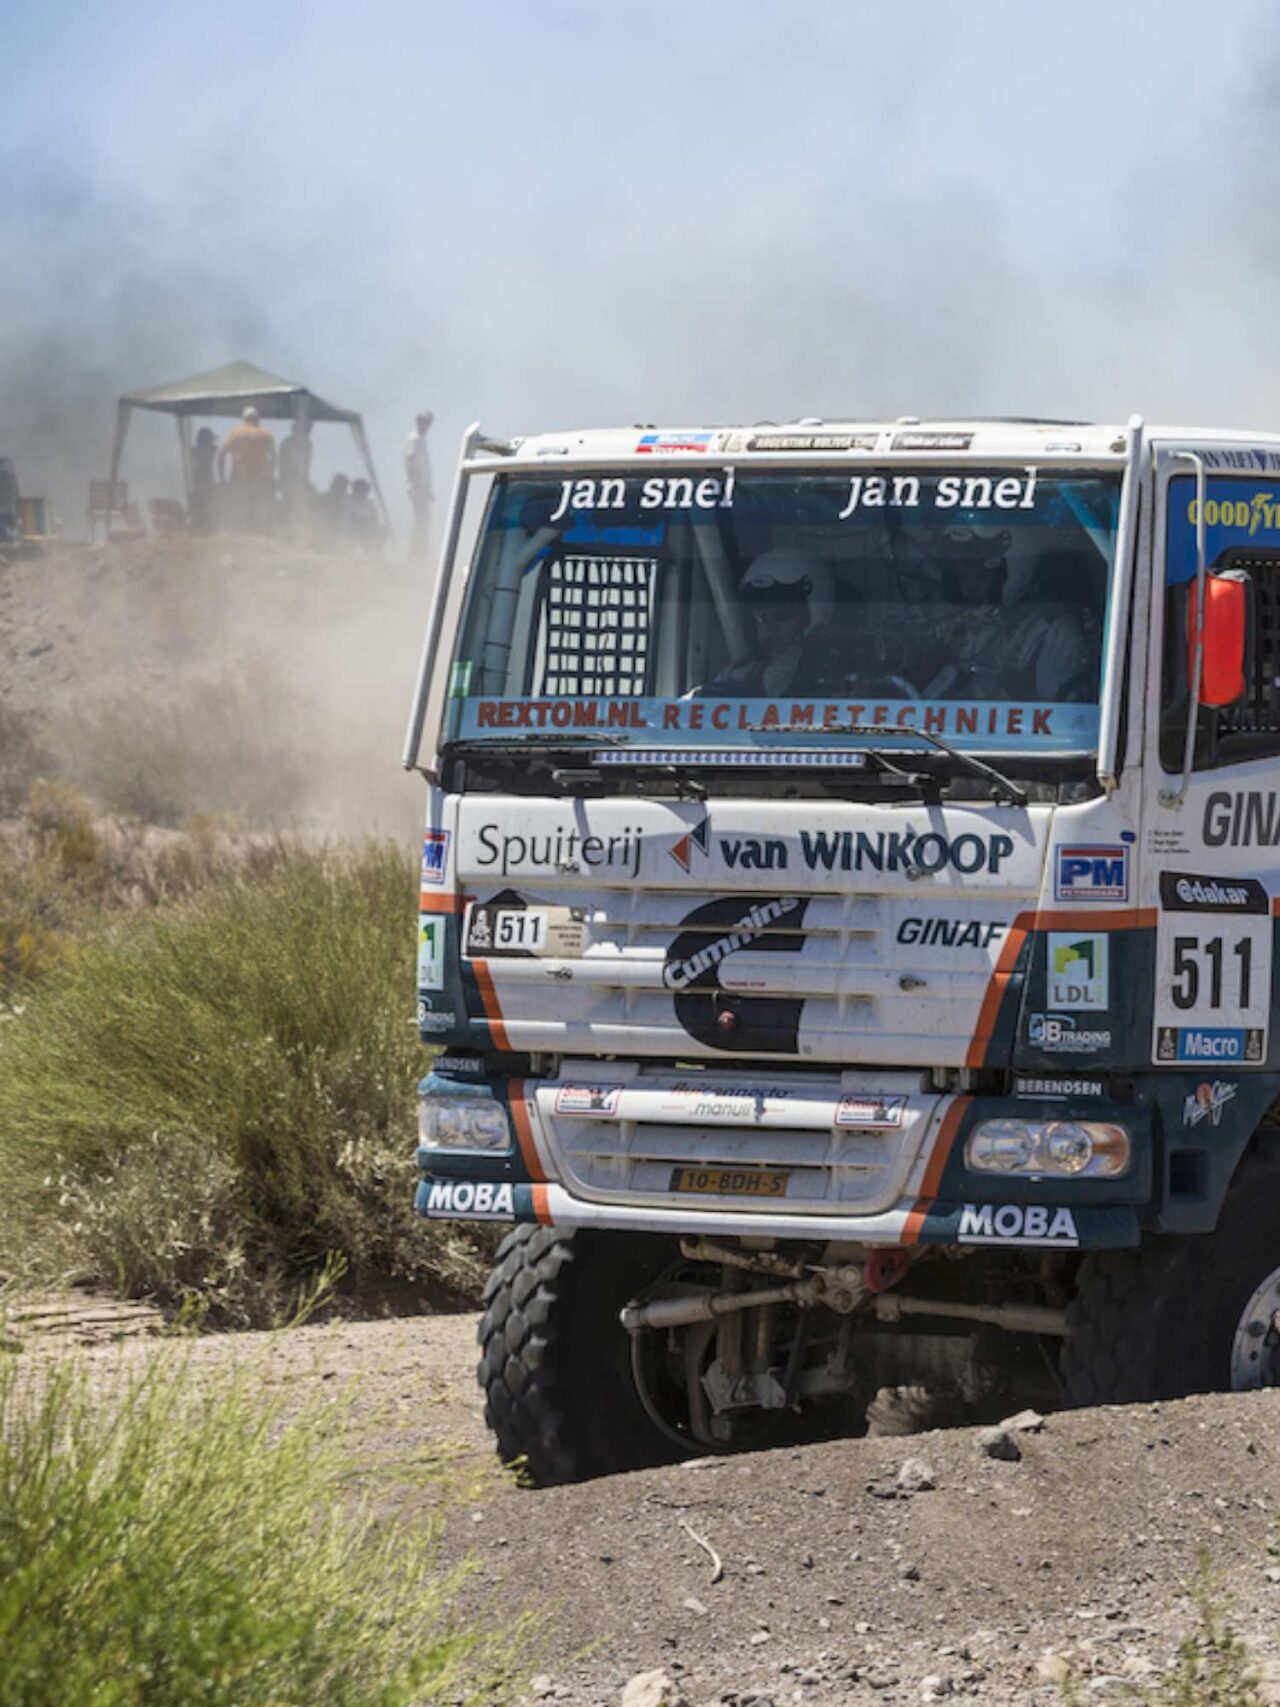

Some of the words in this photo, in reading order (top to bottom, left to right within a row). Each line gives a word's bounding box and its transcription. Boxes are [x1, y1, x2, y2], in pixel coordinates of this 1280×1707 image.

[551, 477, 626, 520] jan
[641, 468, 735, 509] snel
[839, 475, 919, 519] jan
[934, 468, 1037, 510] snel
[477, 698, 646, 730] REXTOM.NL
[662, 703, 1053, 736] RECLAMETECHNIEK
[476, 824, 643, 878] Spuiterij
[720, 838, 788, 870] van
[800, 830, 1014, 874] WINKOOP
[1061, 859, 1125, 887] PM
[1177, 879, 1249, 905] @dakar
[500, 914, 541, 944] 511
[664, 897, 799, 990] Cummins
[897, 917, 1006, 949] GINAF
[1171, 936, 1252, 1010] 511
[1054, 985, 1094, 1004] LDL
[1184, 1033, 1239, 1057] Macro
[1018, 1079, 1102, 1096] BERENDSEN
[427, 1181, 514, 1213] MOBA
[685, 1171, 784, 1192] 10-BDH-5
[961, 1204, 1076, 1239] MOBA
